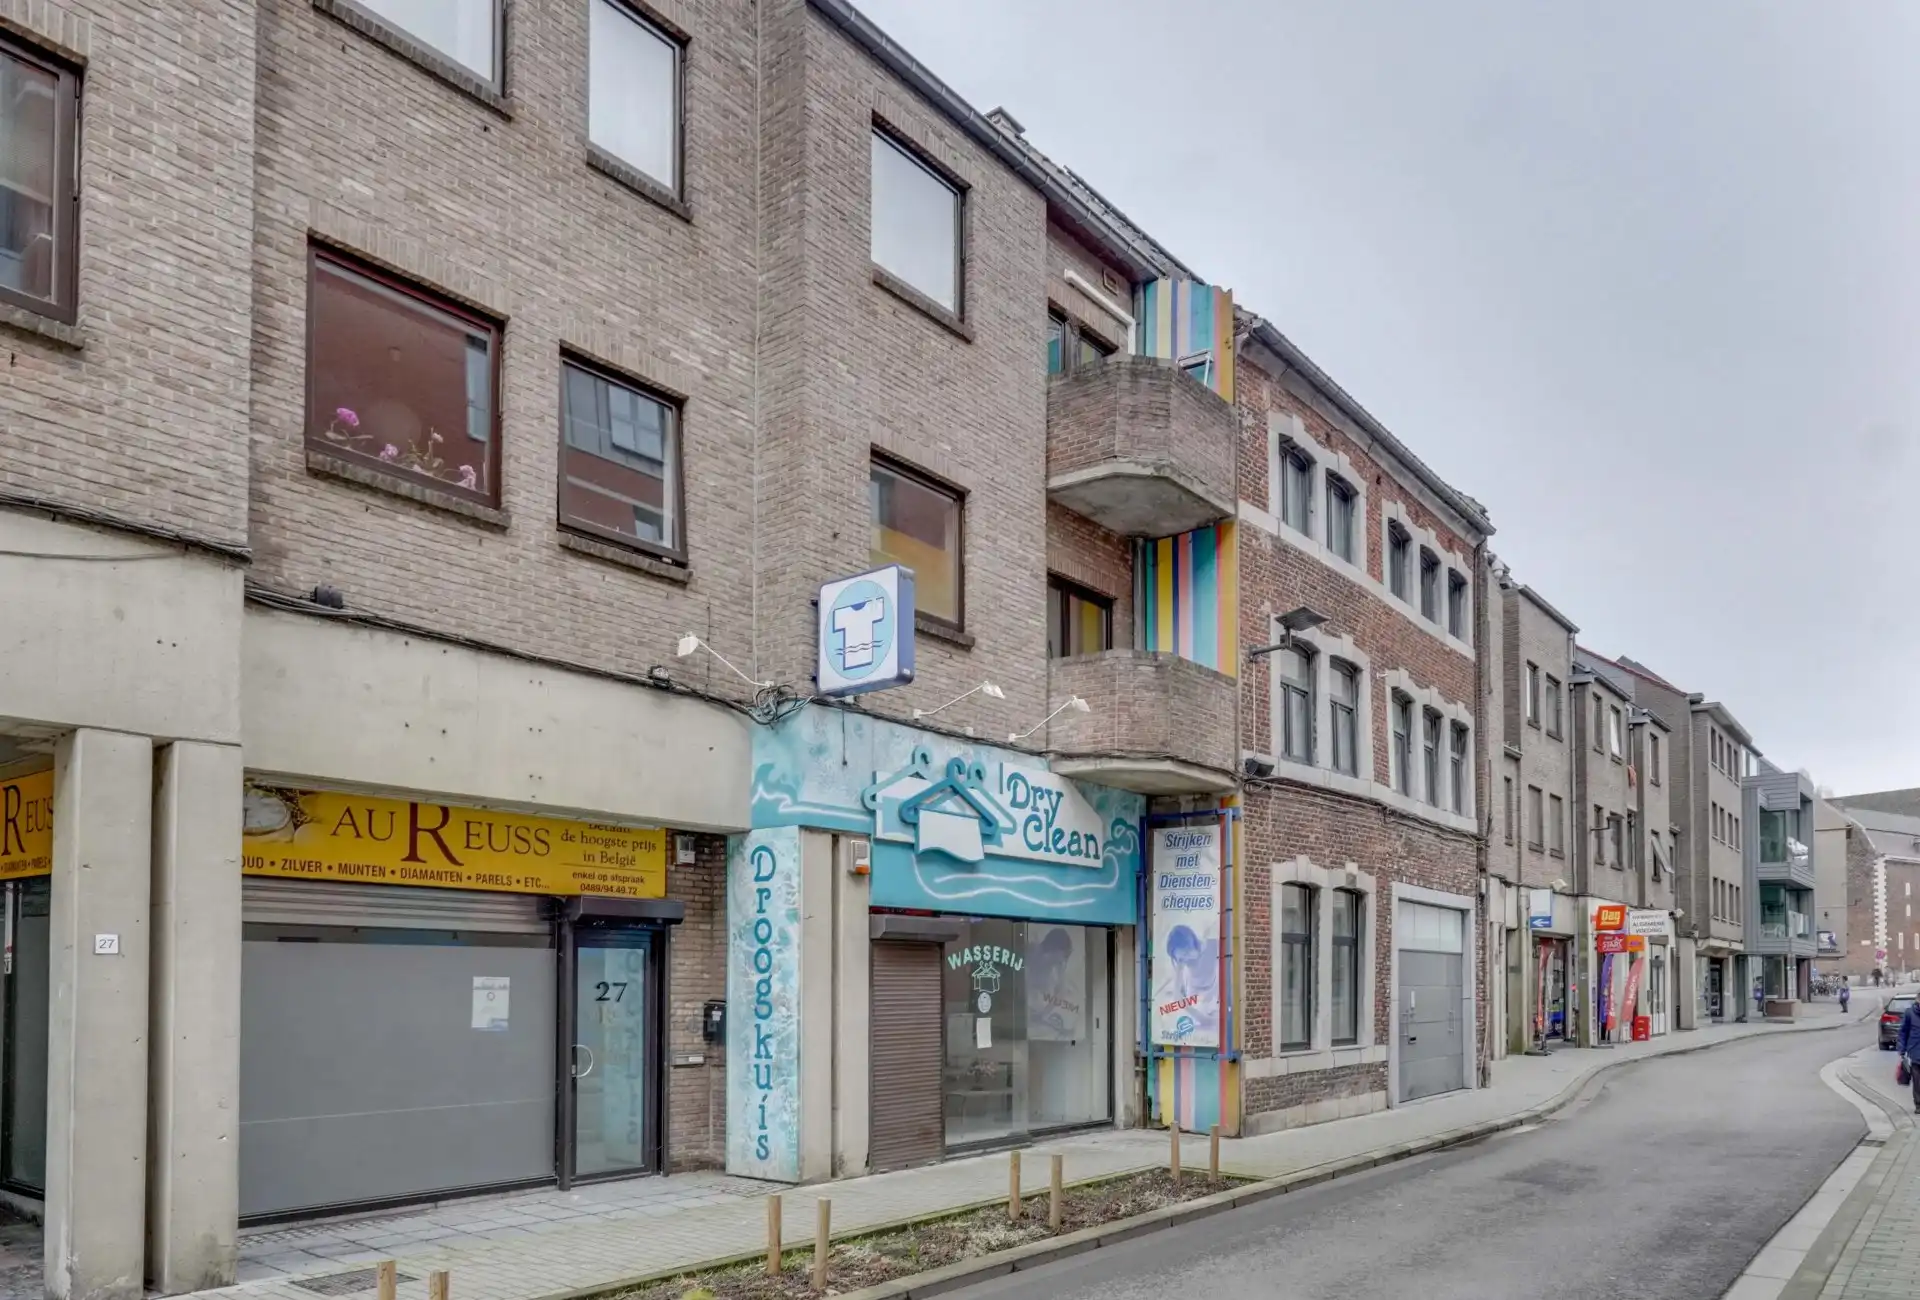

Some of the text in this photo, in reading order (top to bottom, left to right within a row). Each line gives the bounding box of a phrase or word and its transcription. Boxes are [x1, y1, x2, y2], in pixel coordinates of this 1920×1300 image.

[1007, 772, 1064, 828] Dry
[1, 785, 53, 856] REUS
[560, 828, 657, 852] de hoogste prijs
[1023, 808, 1100, 860] Clean
[1165, 833, 1212, 850] Strijken
[583, 850, 636, 867] in België
[1176, 853, 1199, 867] met
[241, 855, 264, 869] OUD
[281, 858, 322, 873] ZILVER
[338, 862, 386, 878] MUNTEN
[400, 867, 462, 883] DIAMANTEN
[476, 873, 512, 886] PARELS
[572, 870, 595, 881] enkel
[1160, 874, 1216, 889] Diensten-
[1163, 895, 1213, 912] cheques
[99, 938, 116, 949] 27
[948, 945, 1024, 971] WASSERIJ
[595, 981, 628, 1003] 27
[750, 845, 776, 1160] Droogkuis
[1160, 994, 1199, 1016] NIEUW
